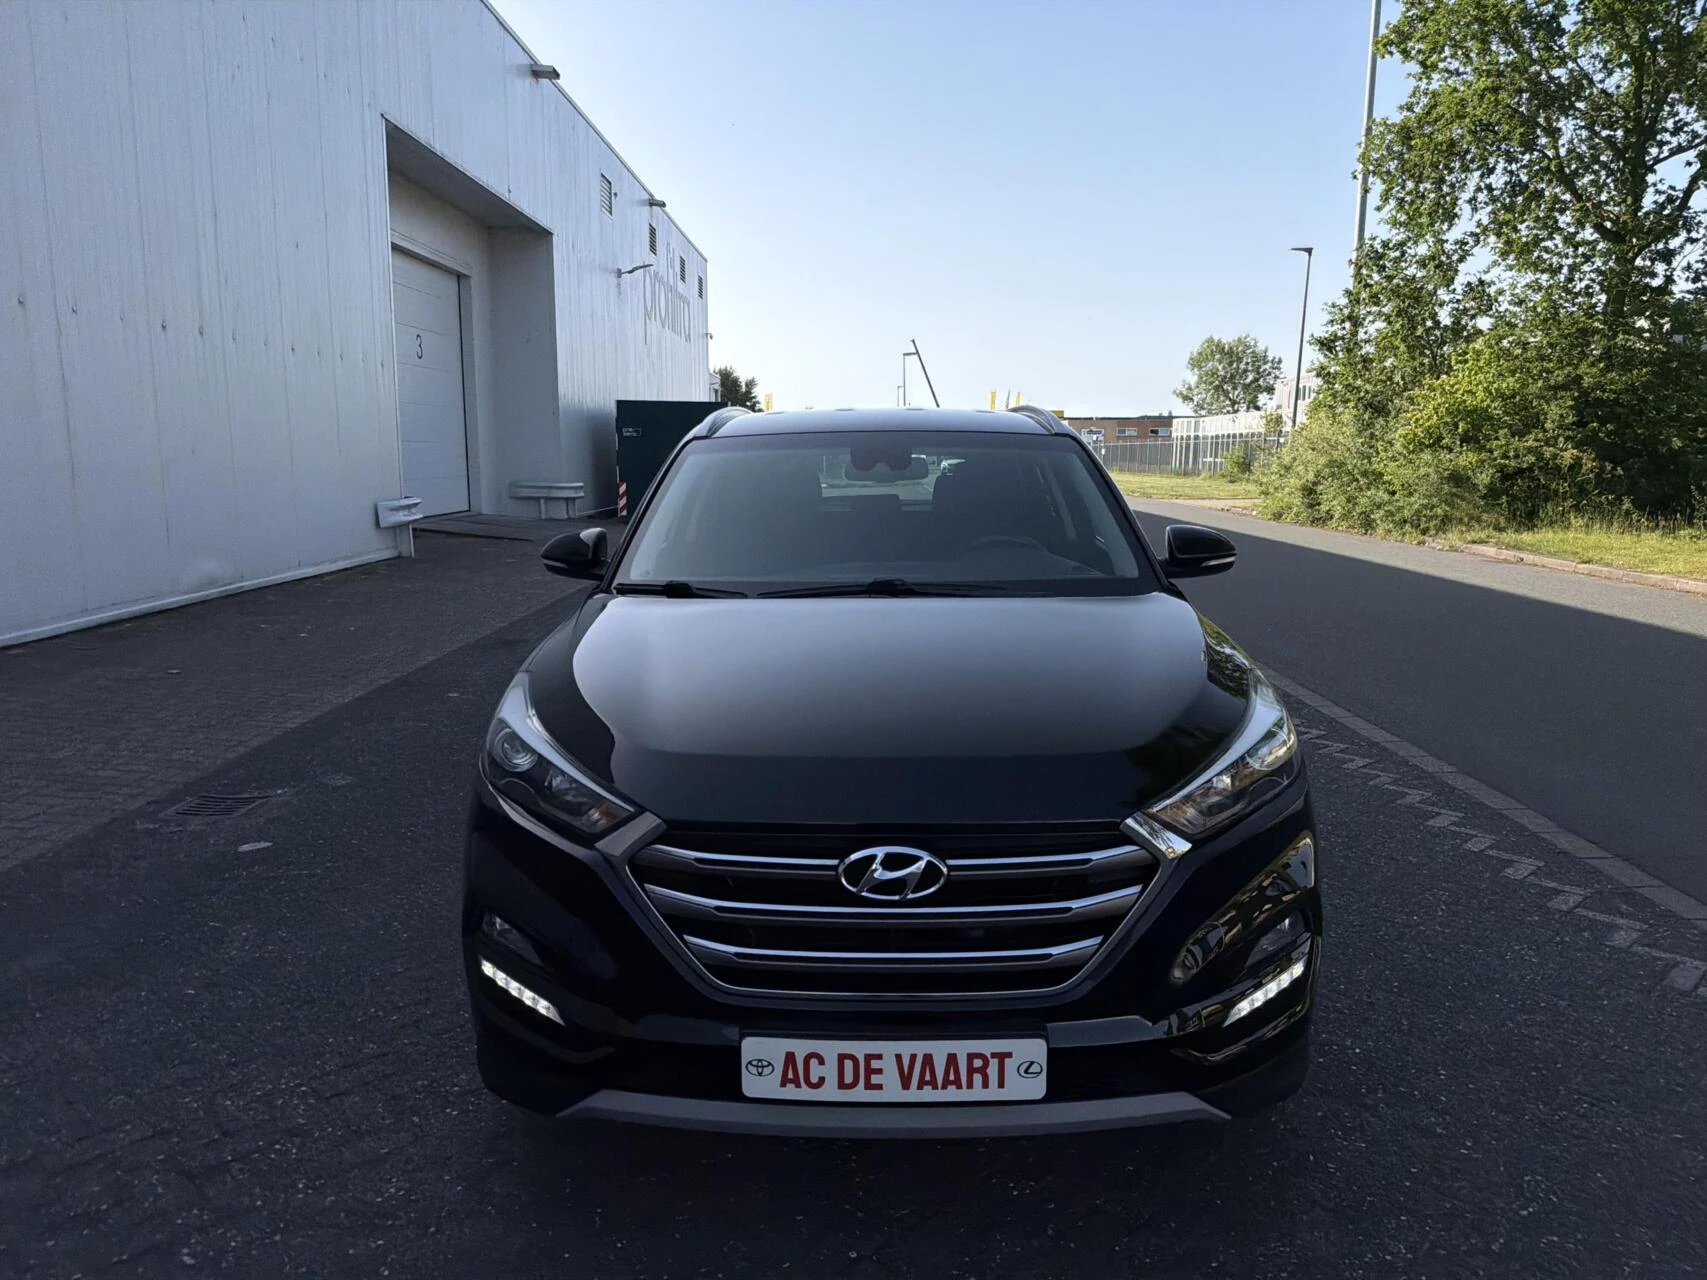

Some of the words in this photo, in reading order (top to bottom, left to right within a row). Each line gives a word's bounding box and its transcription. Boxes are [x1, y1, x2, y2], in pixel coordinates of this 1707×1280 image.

[416, 333, 423, 359] 3
[779, 1051, 826, 1089] AC
[837, 1053, 884, 1090] DE
[894, 1051, 1013, 1091] VAART
